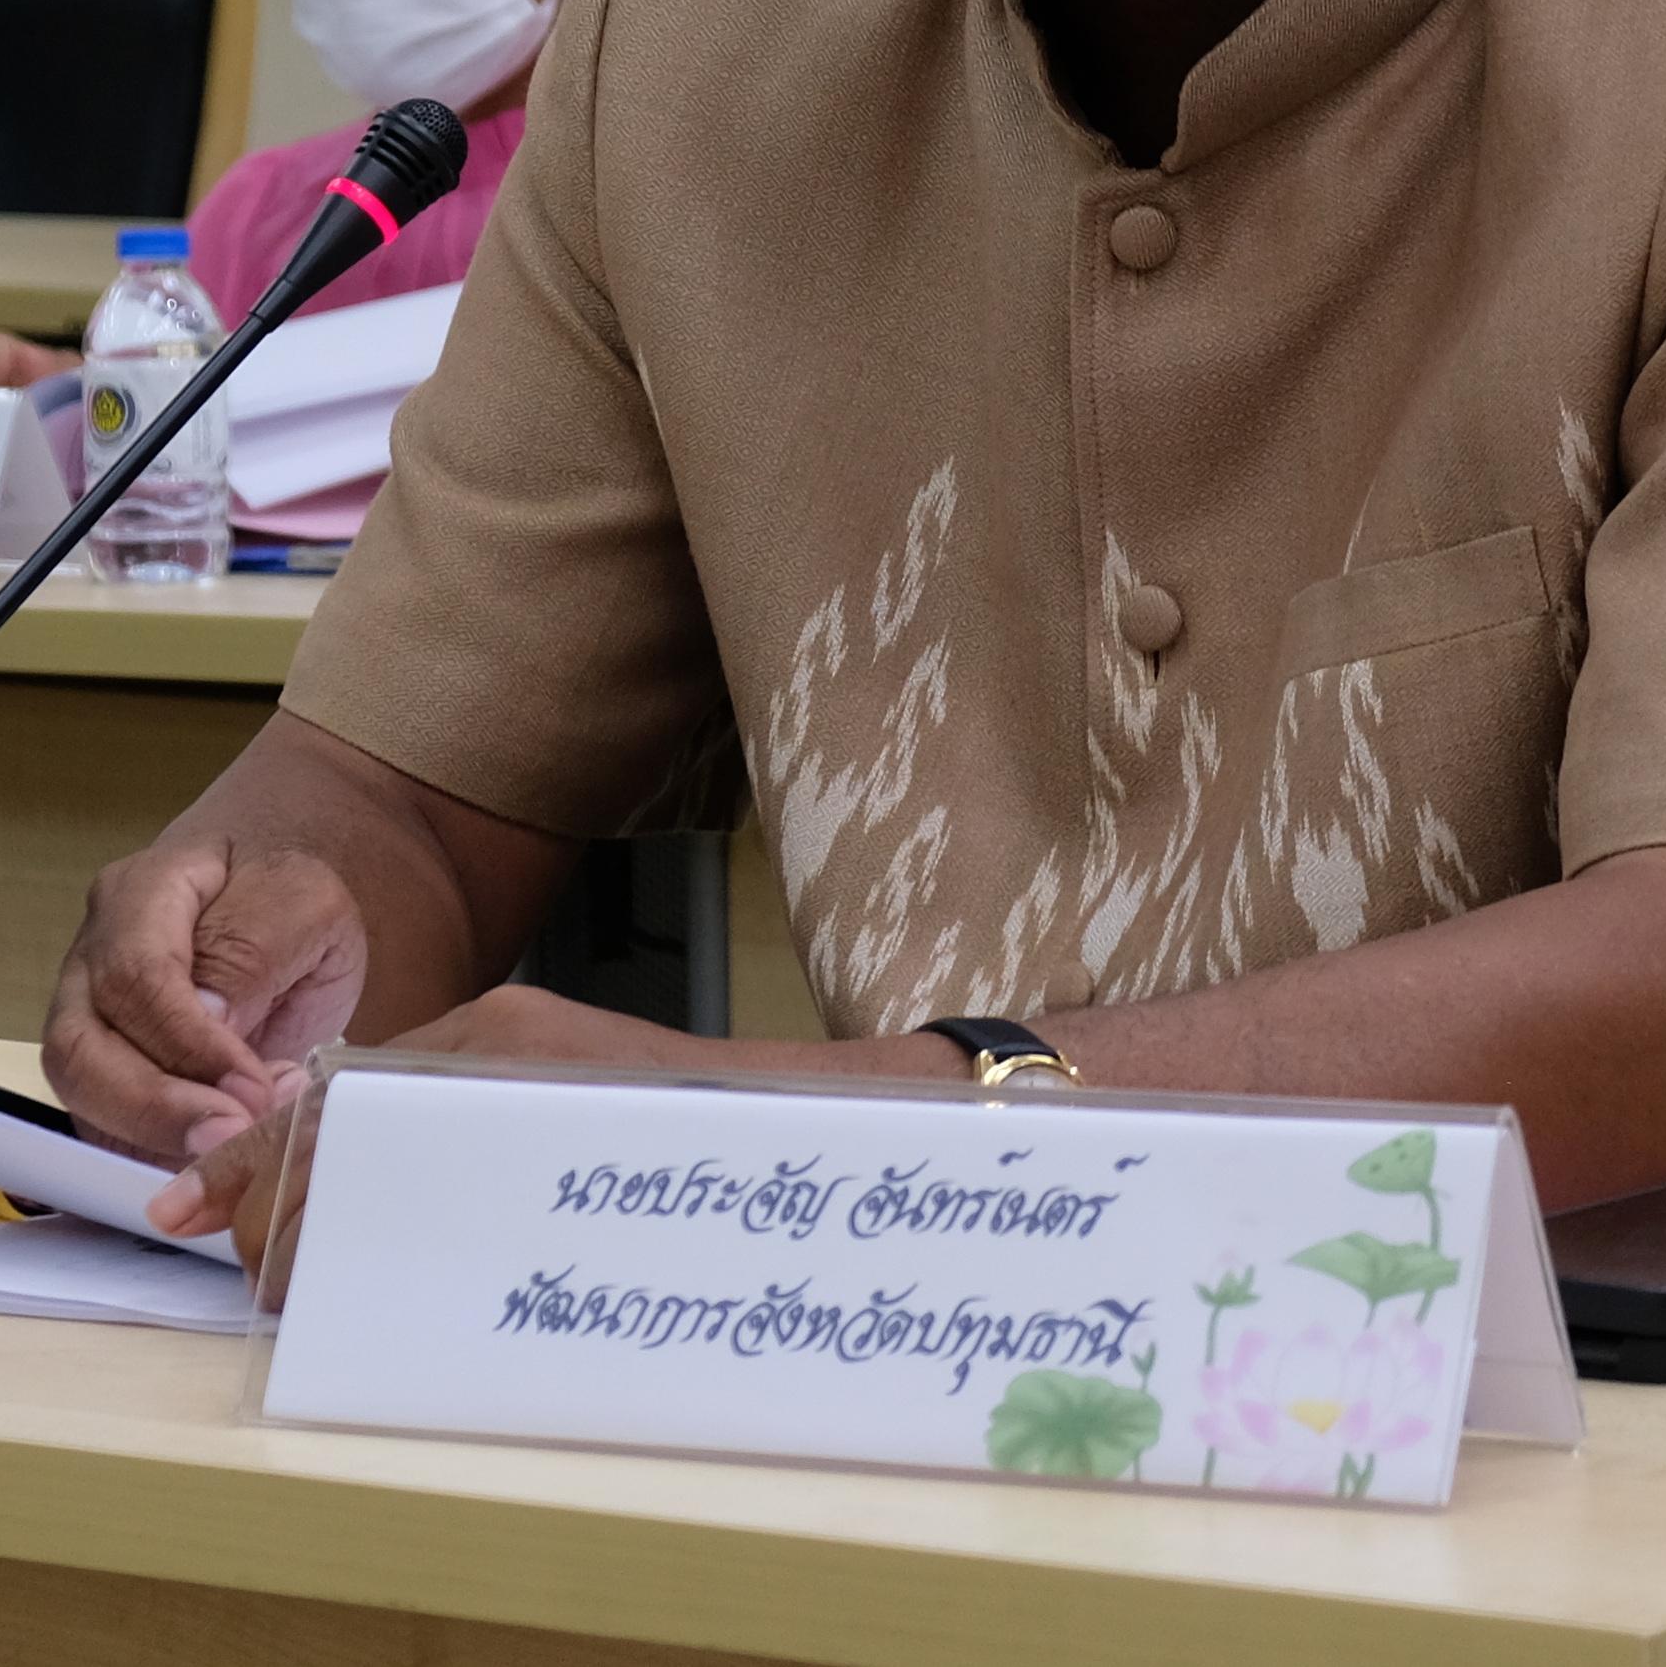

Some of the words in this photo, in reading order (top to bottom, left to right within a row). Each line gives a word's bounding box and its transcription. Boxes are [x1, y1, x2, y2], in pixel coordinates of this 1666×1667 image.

[549, 1154, 853, 1242] นายประจัญ
[494, 1264, 1156, 1398] พัฒนาการจังหวัดปทุมธานี
